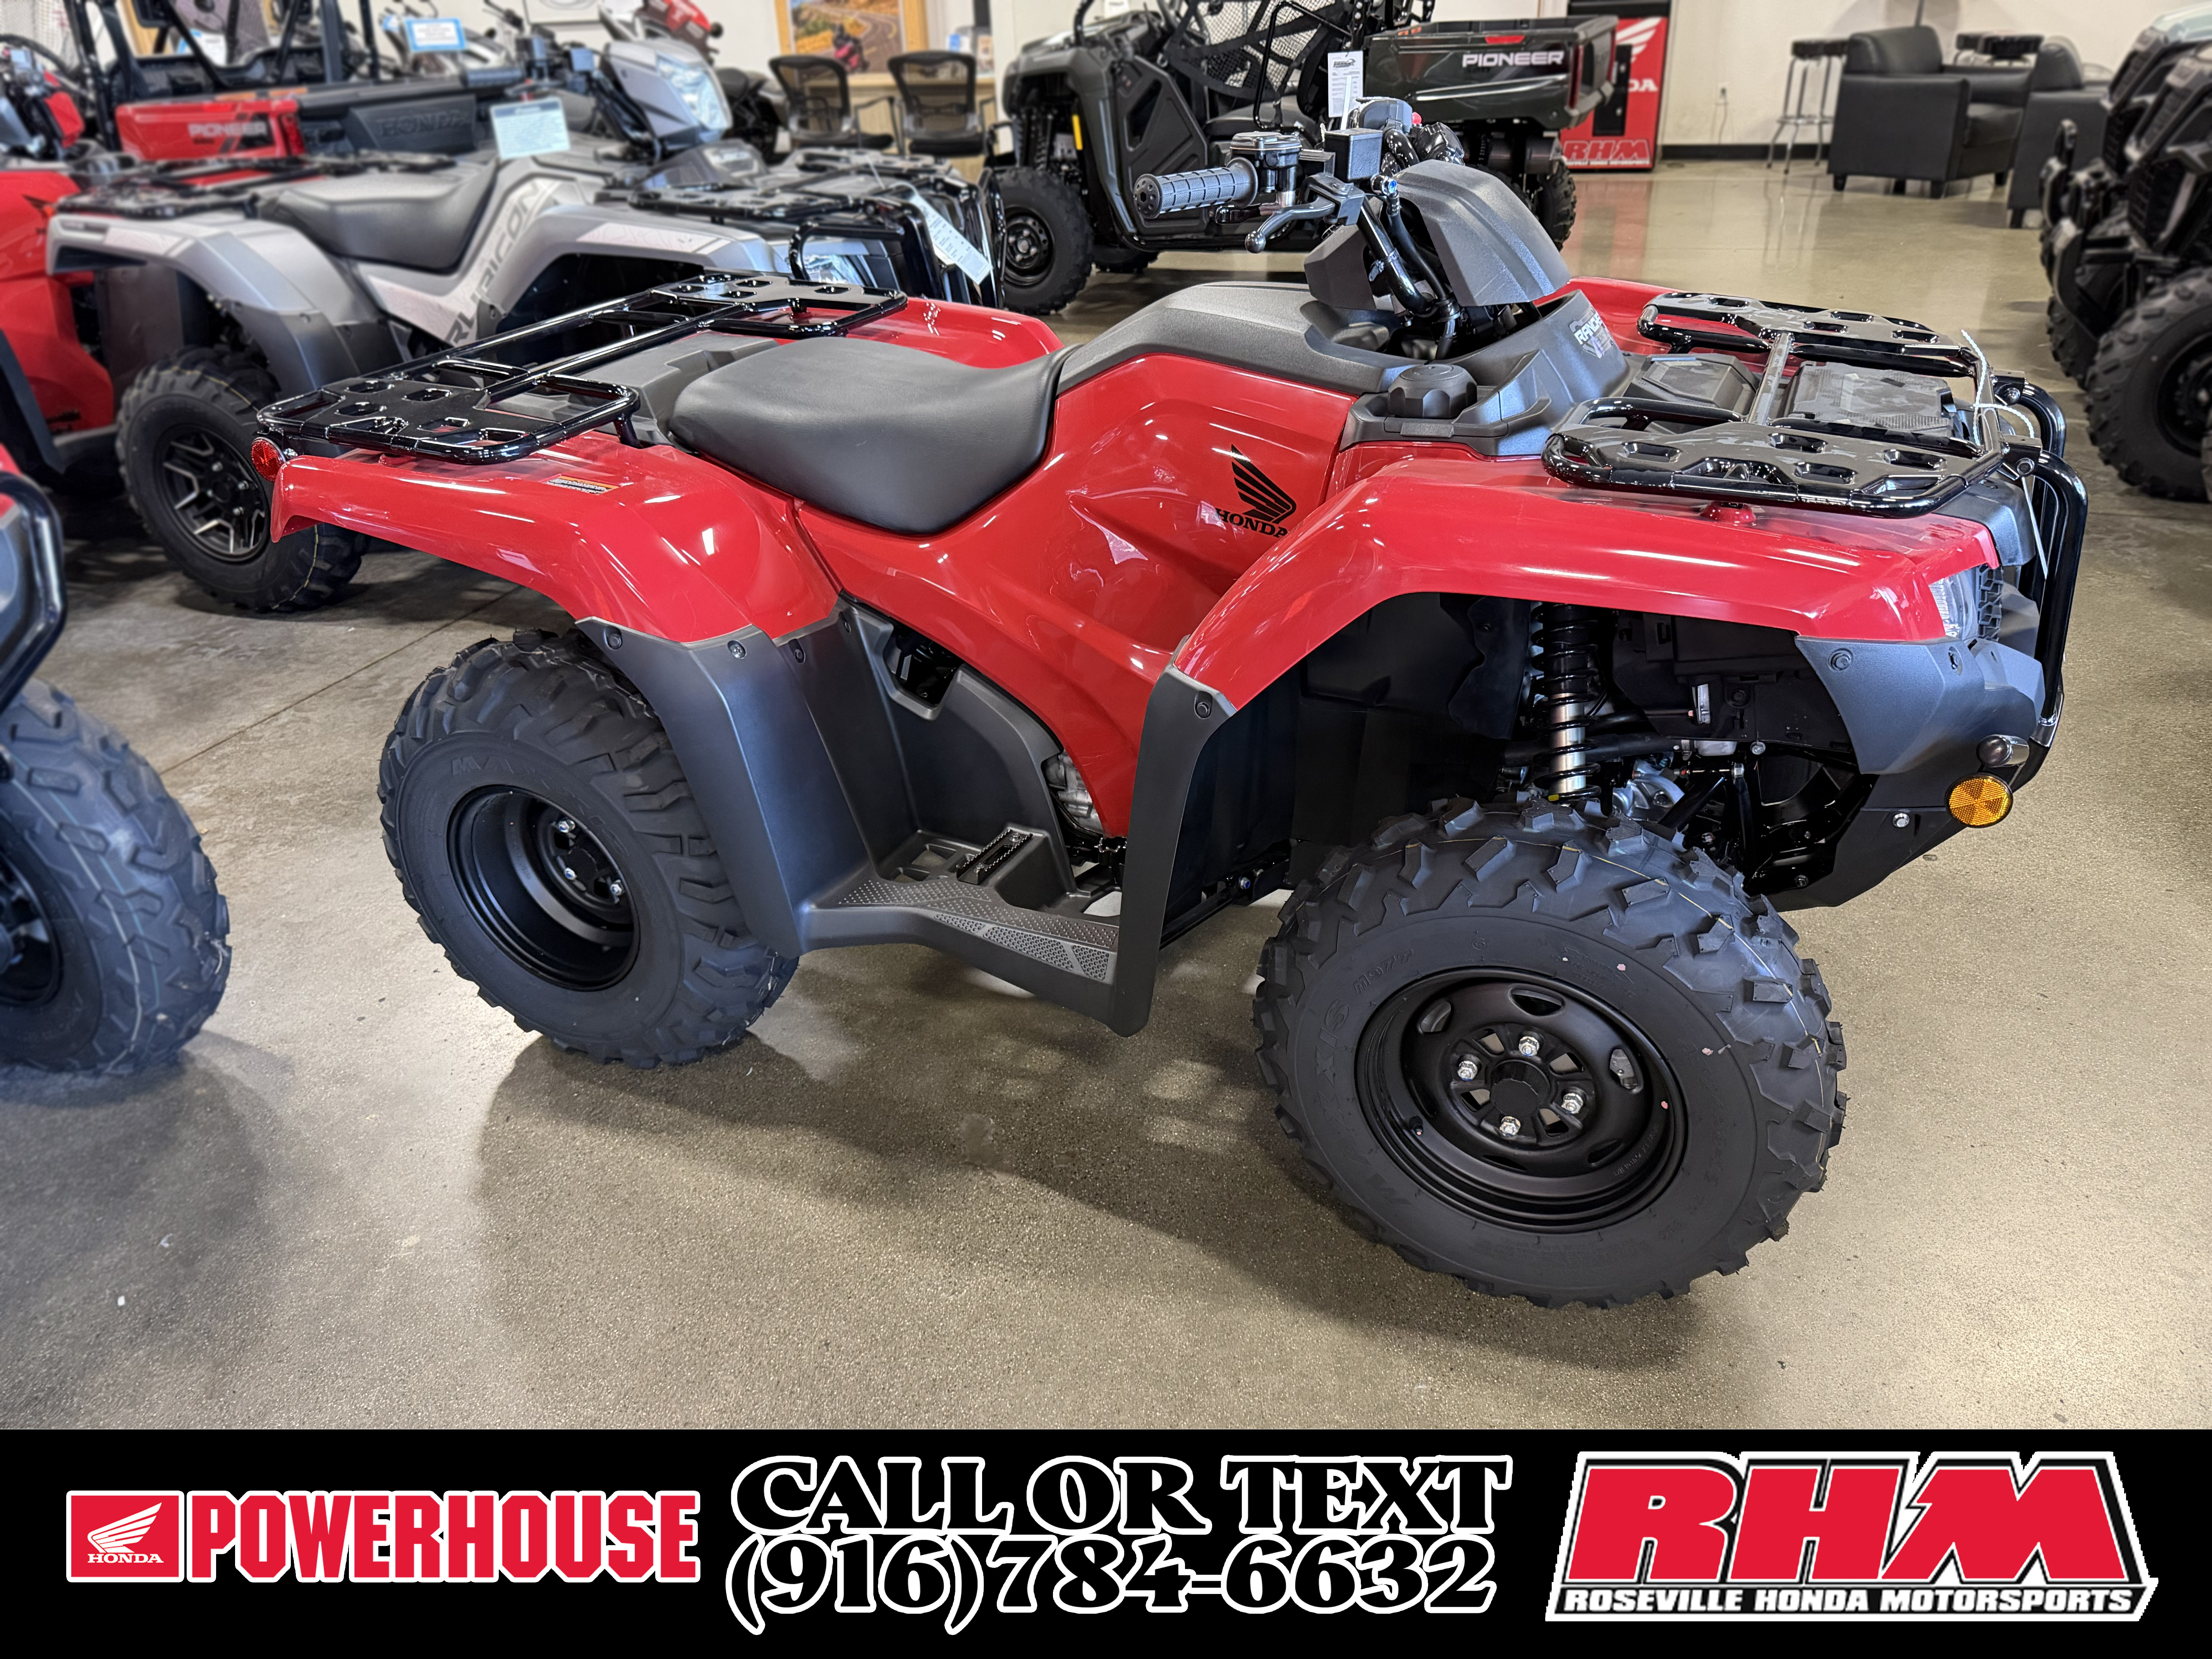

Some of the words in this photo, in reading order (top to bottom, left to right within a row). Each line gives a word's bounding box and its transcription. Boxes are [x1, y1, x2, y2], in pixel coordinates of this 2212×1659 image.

[1462, 51, 1564, 67] PIONEER
[187, 121, 267, 138] PIONEER
[1563, 140, 1650, 160] RHM
[1215, 508, 1288, 538] HONDA
